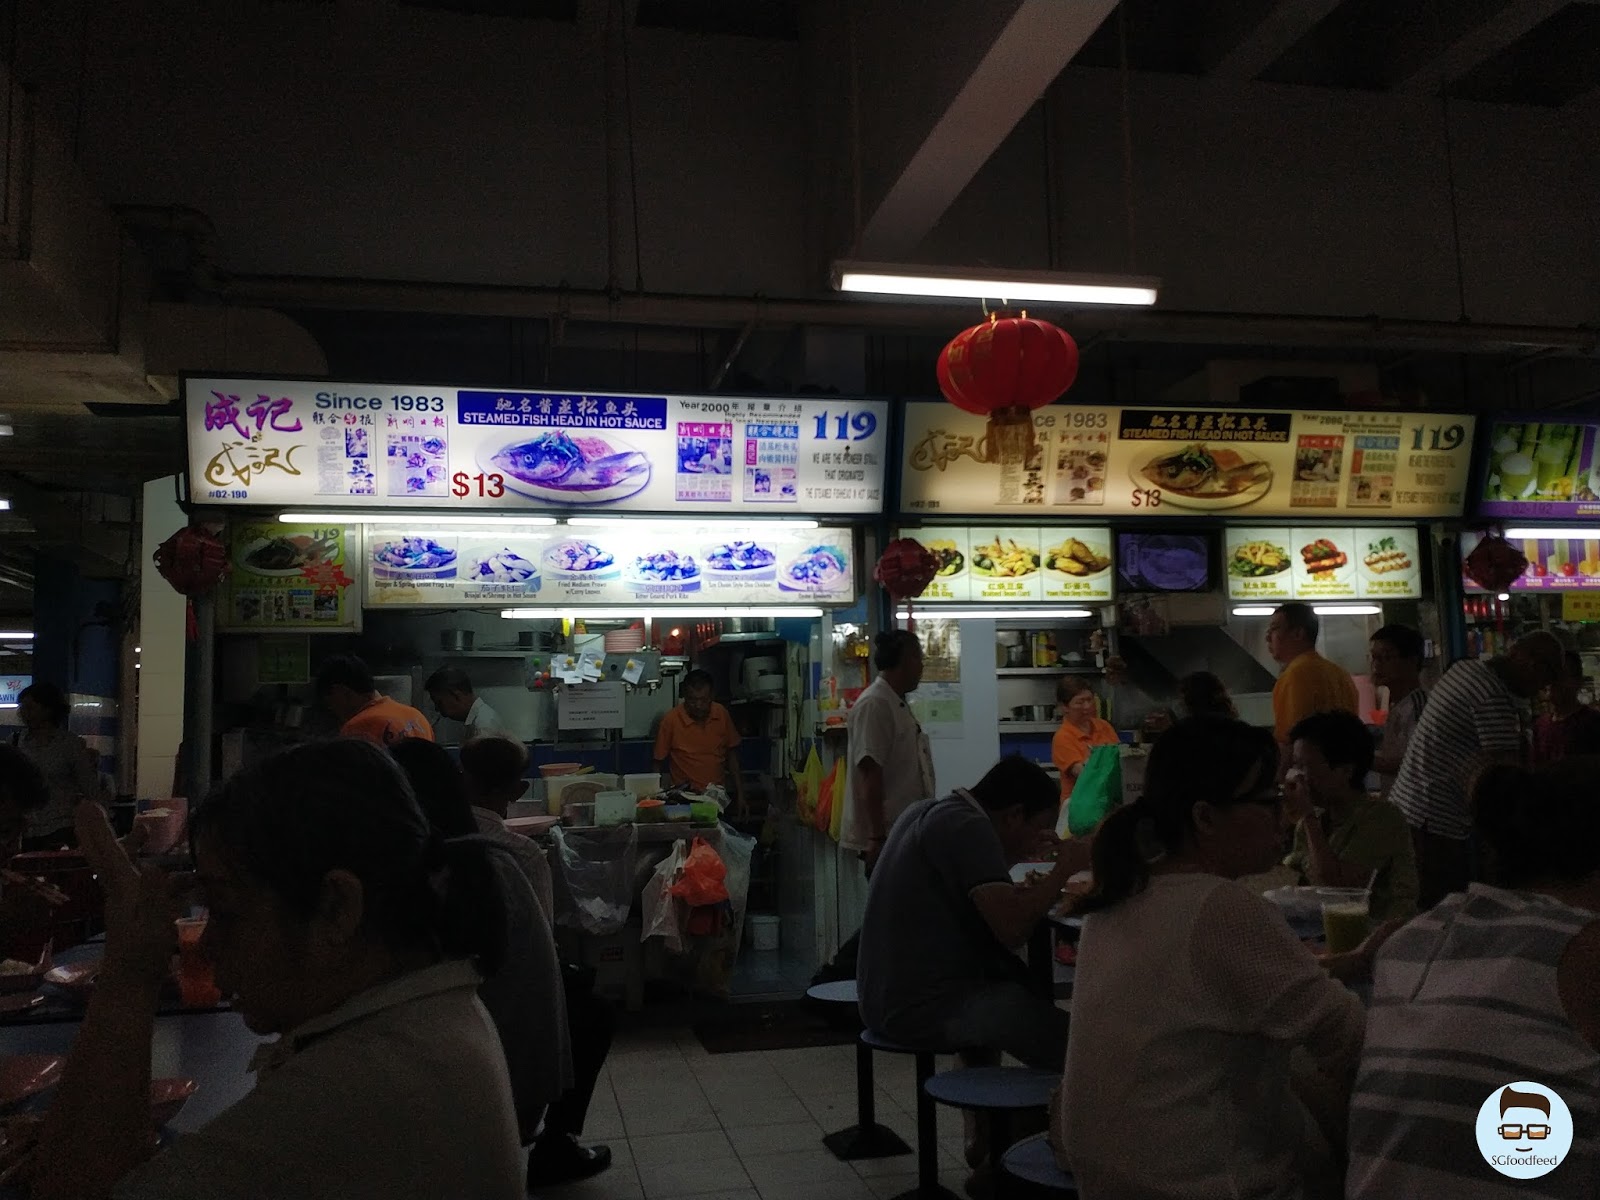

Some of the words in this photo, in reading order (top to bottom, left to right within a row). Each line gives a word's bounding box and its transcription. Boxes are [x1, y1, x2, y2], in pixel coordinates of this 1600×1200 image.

[314, 391, 383, 411] Since
[390, 394, 445, 412] 1983
[679, 400, 700, 409] Year
[701, 402, 730, 413] 2000
[463, 411, 521, 425] STEAMED
[522, 413, 549, 426] FISH
[551, 415, 583, 427] HEAD
[585, 416, 597, 427] IN
[599, 416, 622, 428] HOT
[624, 418, 662, 429] SAUCE
[813, 410, 877, 441] 119
[1063, 411, 1108, 429] 1983
[1122, 428, 1169, 439] STEAMED
[1170, 429, 1193, 439] FISH
[1194, 429, 1221, 440] HEAD
[1222, 430, 1233, 440] IN
[1234, 430, 1254, 440] HOT
[1254, 431, 1287, 442] SAUCE
[1410, 423, 1466, 451] 119
[452, 471, 505, 500] $13
[312, 528, 340, 540] 119
